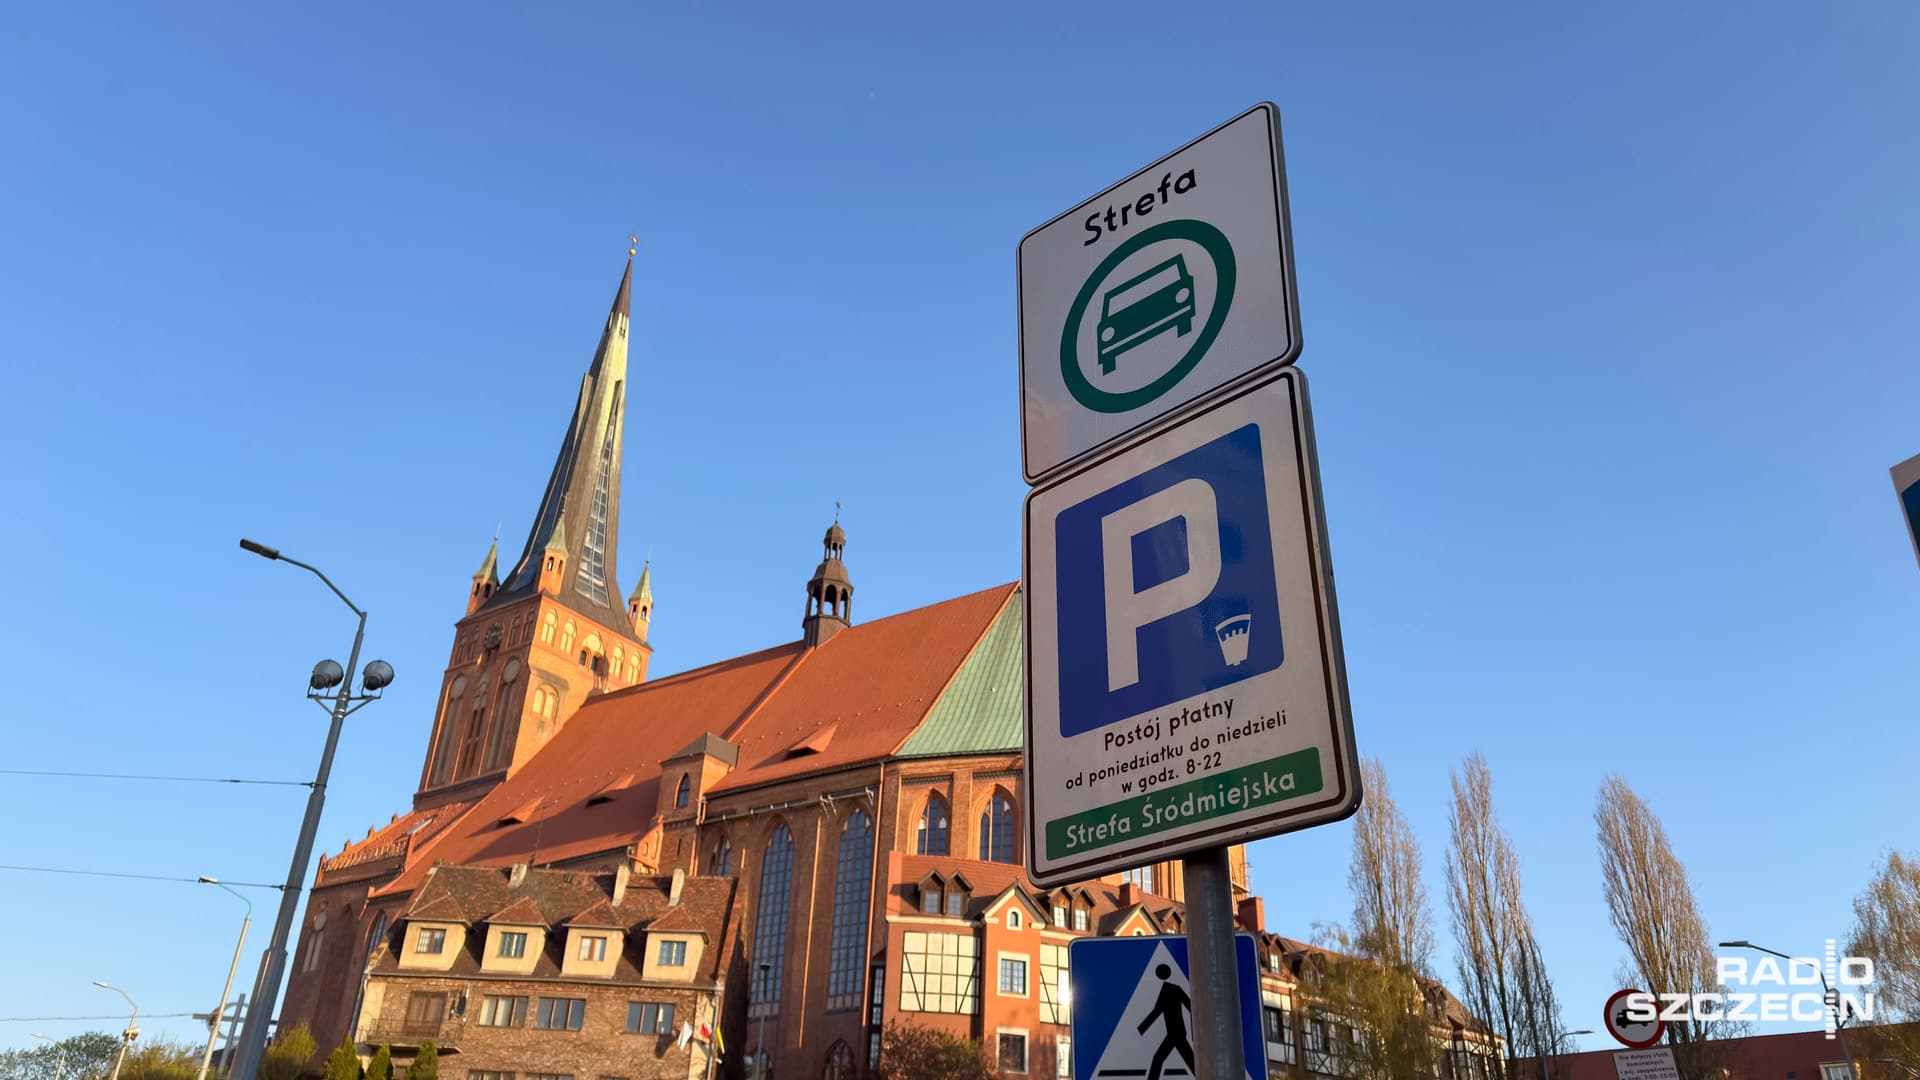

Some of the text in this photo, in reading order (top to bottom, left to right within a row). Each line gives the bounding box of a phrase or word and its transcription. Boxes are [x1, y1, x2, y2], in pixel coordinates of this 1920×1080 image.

[1084, 168, 1197, 246] Strefa
[1101, 478, 1222, 692] P
[1066, 710, 1287, 790] od poniedziałku do niedzieli
[1104, 698, 1234, 751] Postój płatny
[1066, 770, 1295, 848] Strefa Śródmiejska
[1122, 752, 1222, 794] w godz. 8-22
